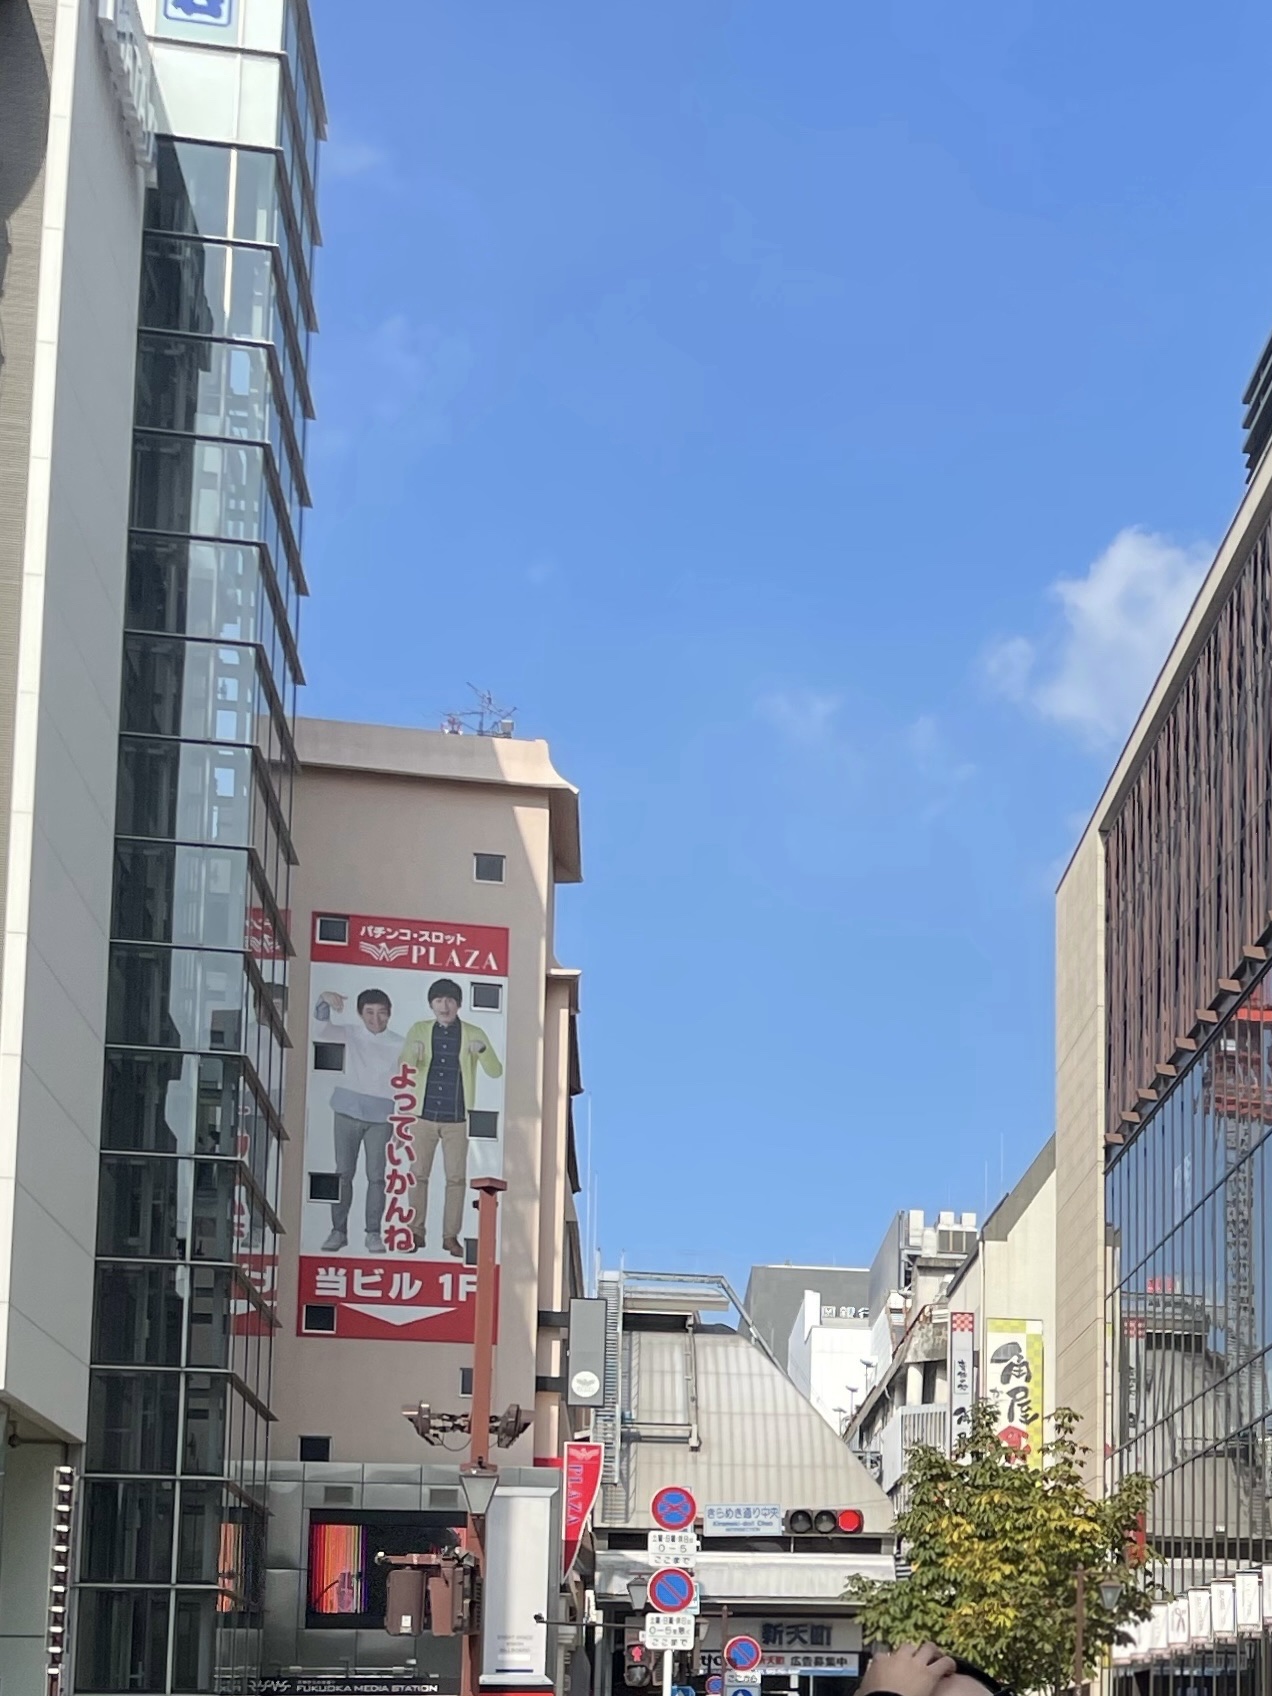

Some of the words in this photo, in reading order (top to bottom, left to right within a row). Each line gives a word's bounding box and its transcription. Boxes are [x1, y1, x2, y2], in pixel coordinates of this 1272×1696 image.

[360, 925, 467, 945] パチンコ・スロット
[411, 944, 499, 972] PLAZA
[384, 1063, 418, 1253] よっていかんね
[314, 1266, 422, 1300] 当ビル
[439, 1273, 477, 1301] 1F
[566, 1464, 584, 1526] PLAZA
[707, 1507, 780, 1519] きらめき通り中央
[654, 1556, 691, 1565] ここまで
[651, 1638, 688, 1647] ここまで
[761, 1622, 833, 1646] 新天町
[790, 1655, 848, 1668] 広告募集中
[296, 1684, 351, 1692] FUKUOKA
[353, 1684, 389, 1692] MEDIA
[392, 1684, 438, 1692] STATION
